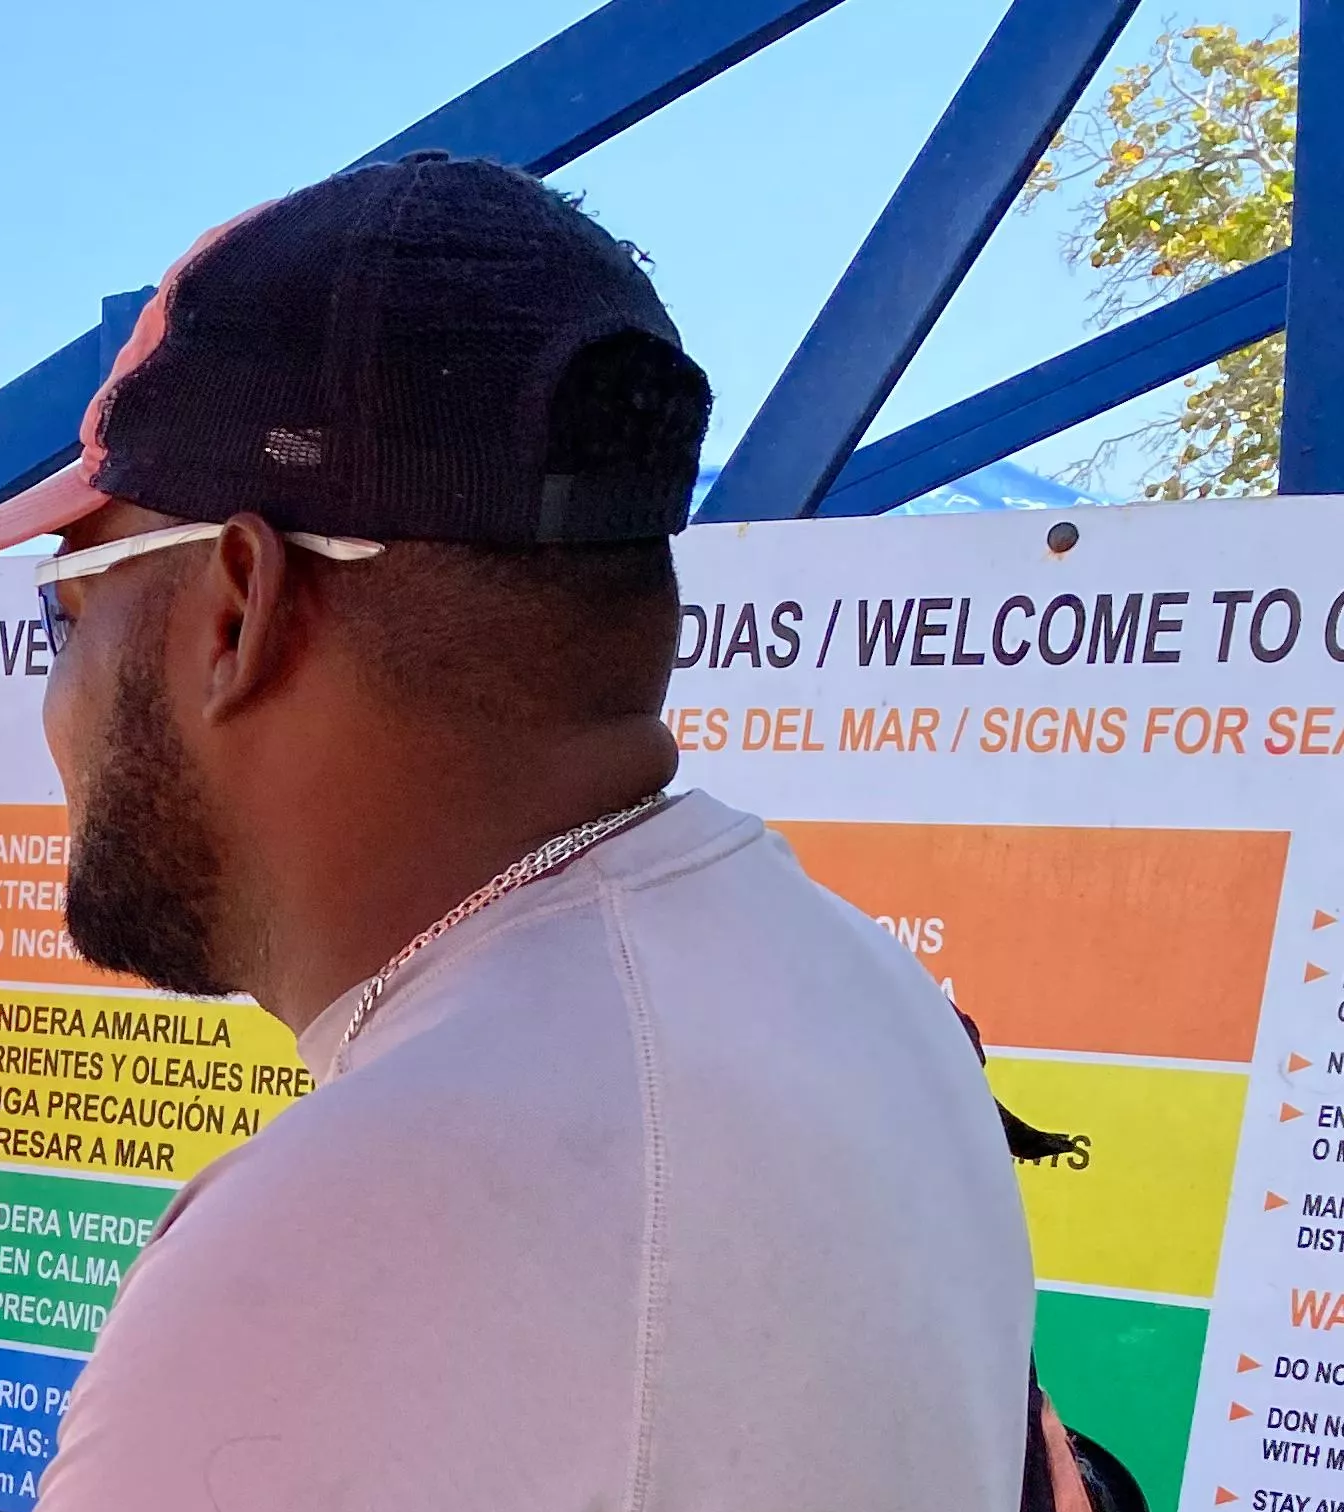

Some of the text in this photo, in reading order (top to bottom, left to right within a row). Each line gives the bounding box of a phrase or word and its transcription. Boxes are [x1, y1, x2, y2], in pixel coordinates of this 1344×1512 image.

[858, 592, 1190, 668] WELCOME
[1213, 588, 1302, 663] TO
[665, 707, 729, 752] ES
[742, 707, 824, 752] DEL
[839, 707, 940, 752] MAR
[979, 706, 1127, 754] SIGNS
[1143, 706, 1249, 754] FOR
[91, 1010, 231, 1049] AMARILLA
[110, 1053, 128, 1083] Y
[132, 1055, 243, 1094] OLEAJES
[47, 1091, 225, 1135] PRECAUCIÓN
[88, 1137, 107, 1166] A
[114, 1138, 174, 1173] MAR
[68, 1210, 154, 1248] VERDE
[37, 1250, 121, 1288] CALMA
[1274, 1356, 1309, 1381] DO
[1266, 1407, 1319, 1435] DON
[1262, 1438, 1321, 1468] WITH
[19, 1471, 37, 1499] A
